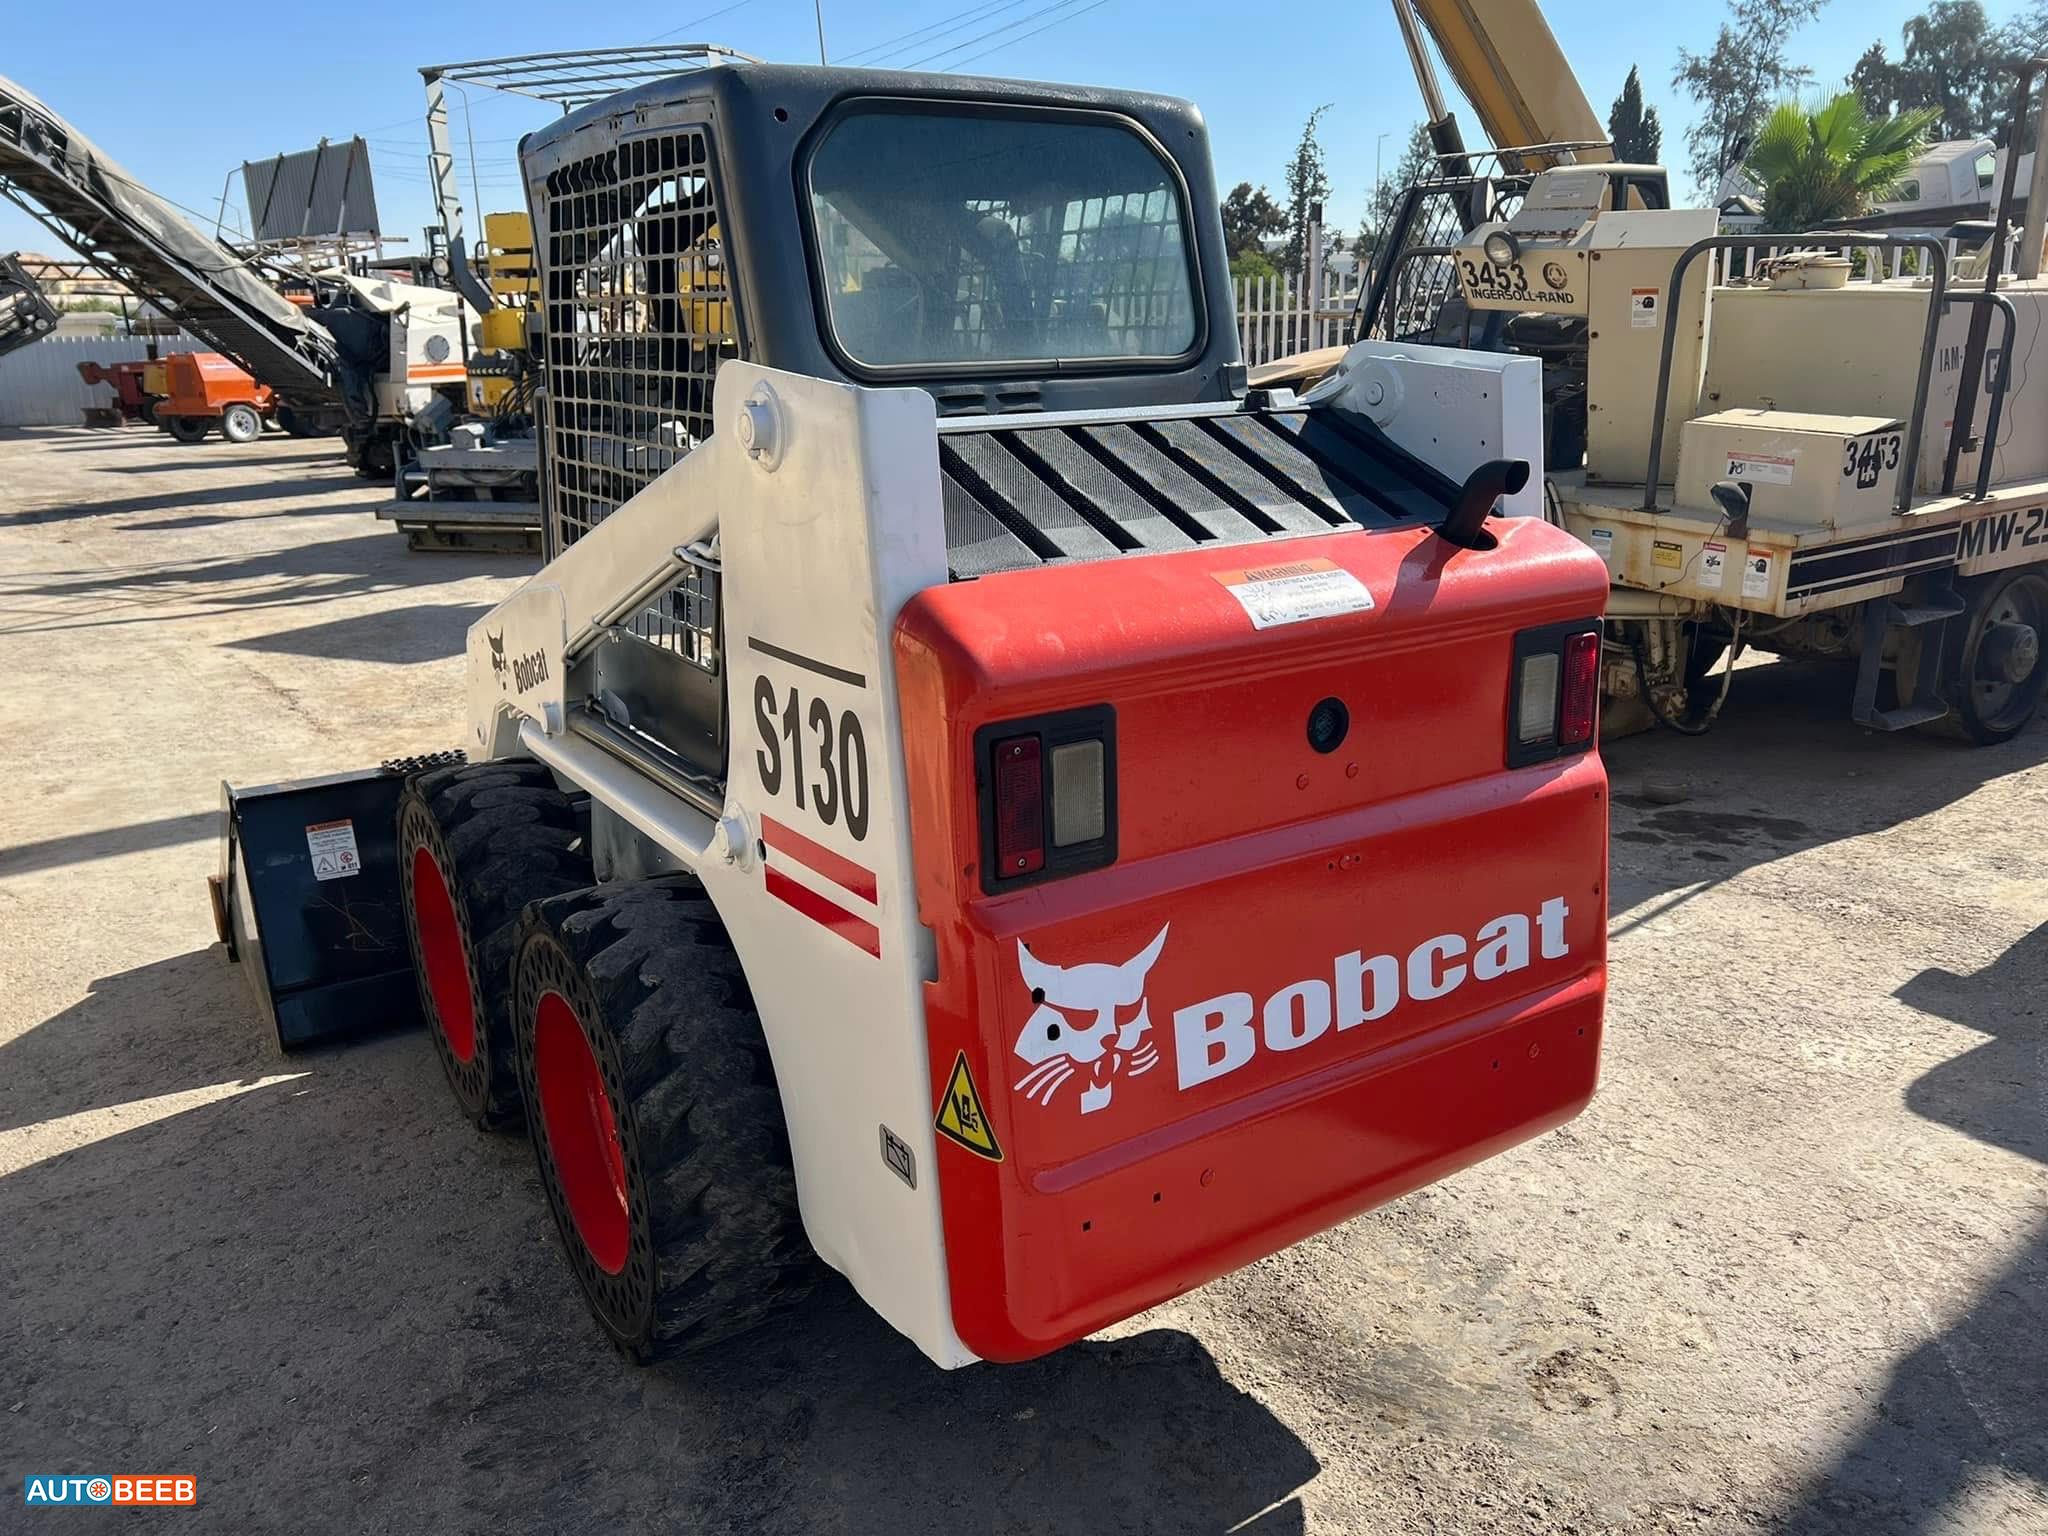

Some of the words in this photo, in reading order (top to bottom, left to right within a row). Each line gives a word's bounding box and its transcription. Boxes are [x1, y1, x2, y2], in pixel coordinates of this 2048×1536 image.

[1462, 259, 1528, 291] 3453
[1470, 286, 1574, 304] INGERSOLL-RAND
[1939, 344, 1967, 373] IAM-
[513, 647, 550, 695] Bobcat
[754, 674, 869, 842] S130
[1173, 896, 1569, 1091] Bobcat
